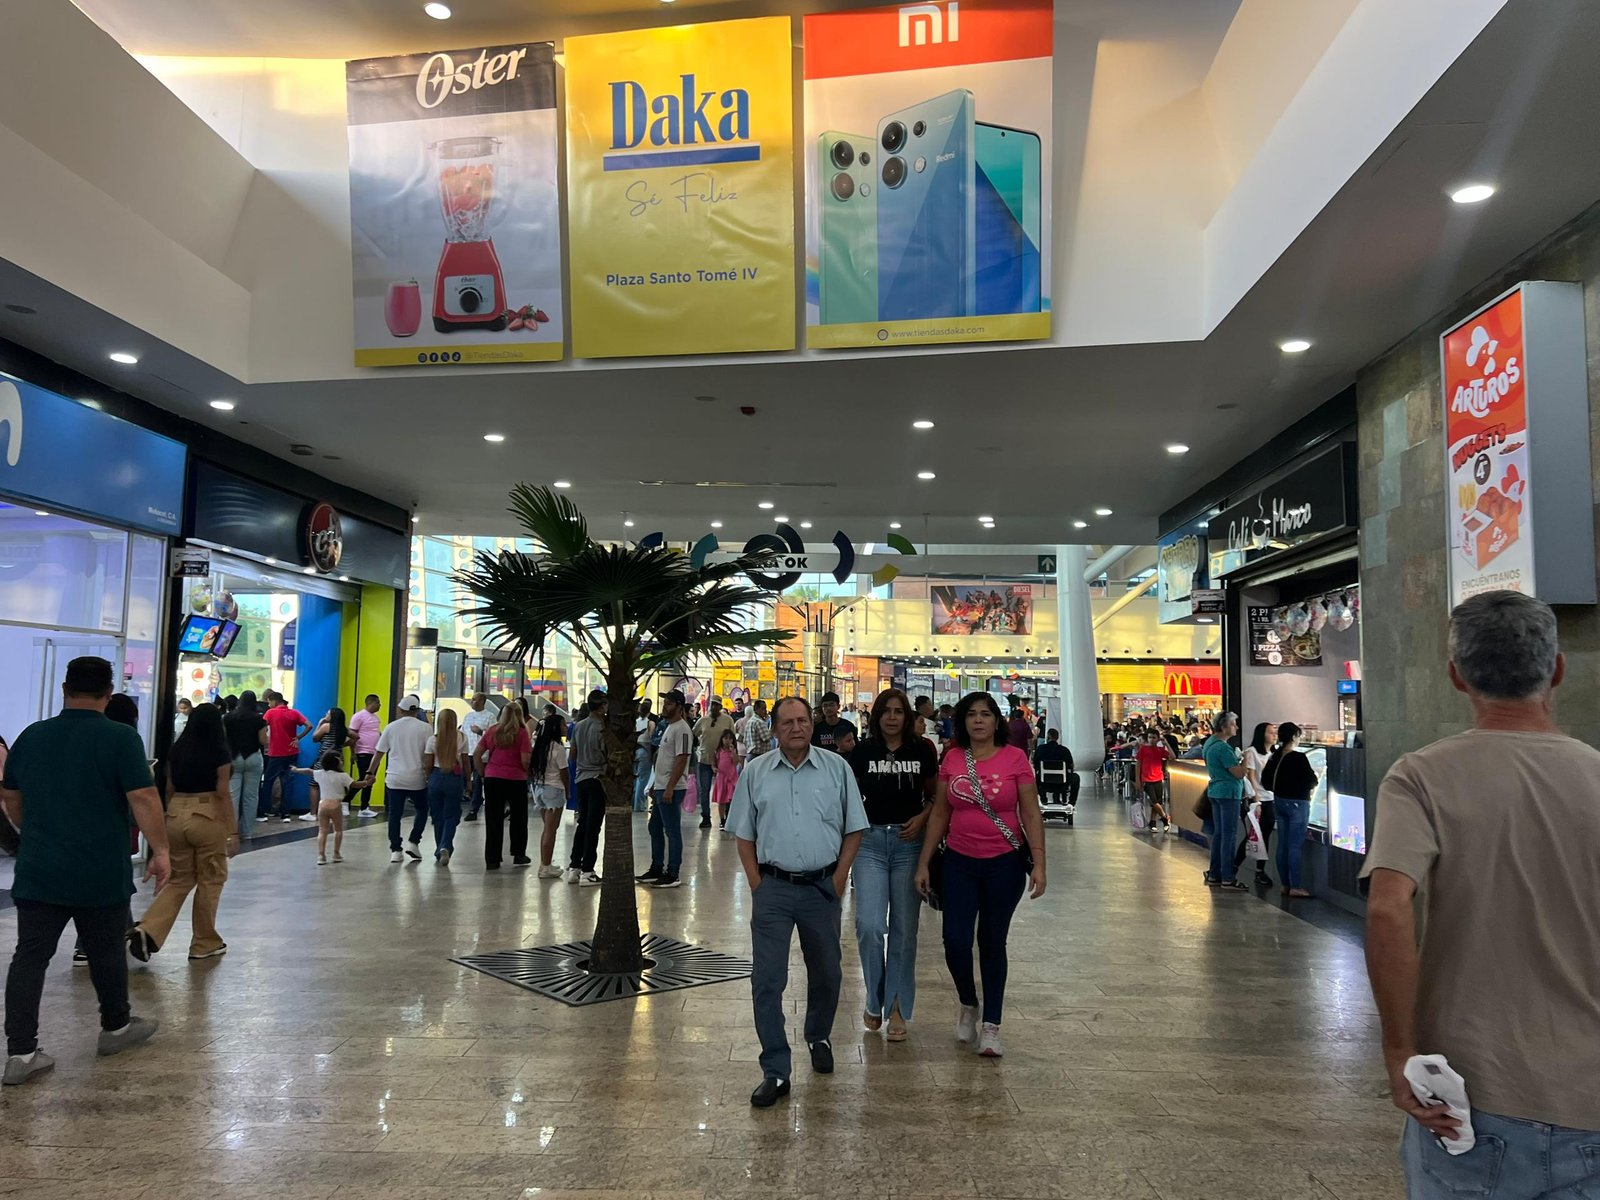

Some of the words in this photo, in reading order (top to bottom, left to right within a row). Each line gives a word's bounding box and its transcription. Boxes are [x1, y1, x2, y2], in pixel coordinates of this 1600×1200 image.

[416, 47, 527, 108] Oster
[608, 74, 750, 150] Daka
[625, 180, 662, 216] Sé
[670, 173, 738, 213] Feliz
[606, 273, 645, 287] Plaza
[649, 271, 692, 285] Santo
[697, 268, 738, 282] Tomé
[742, 267, 758, 280] IV
[892, 326, 985, 339] www.tiendasdaka.com
[1451, 357, 1520, 418] ARTUROS
[1452, 423, 1506, 473] NUGGETS
[785, 557, 808, 569] OK
[1461, 568, 1521, 590] ENCUÉNTRANOS
[1258, 644, 1281, 652] PIZZA
[868, 760, 921, 774] AMOUR
